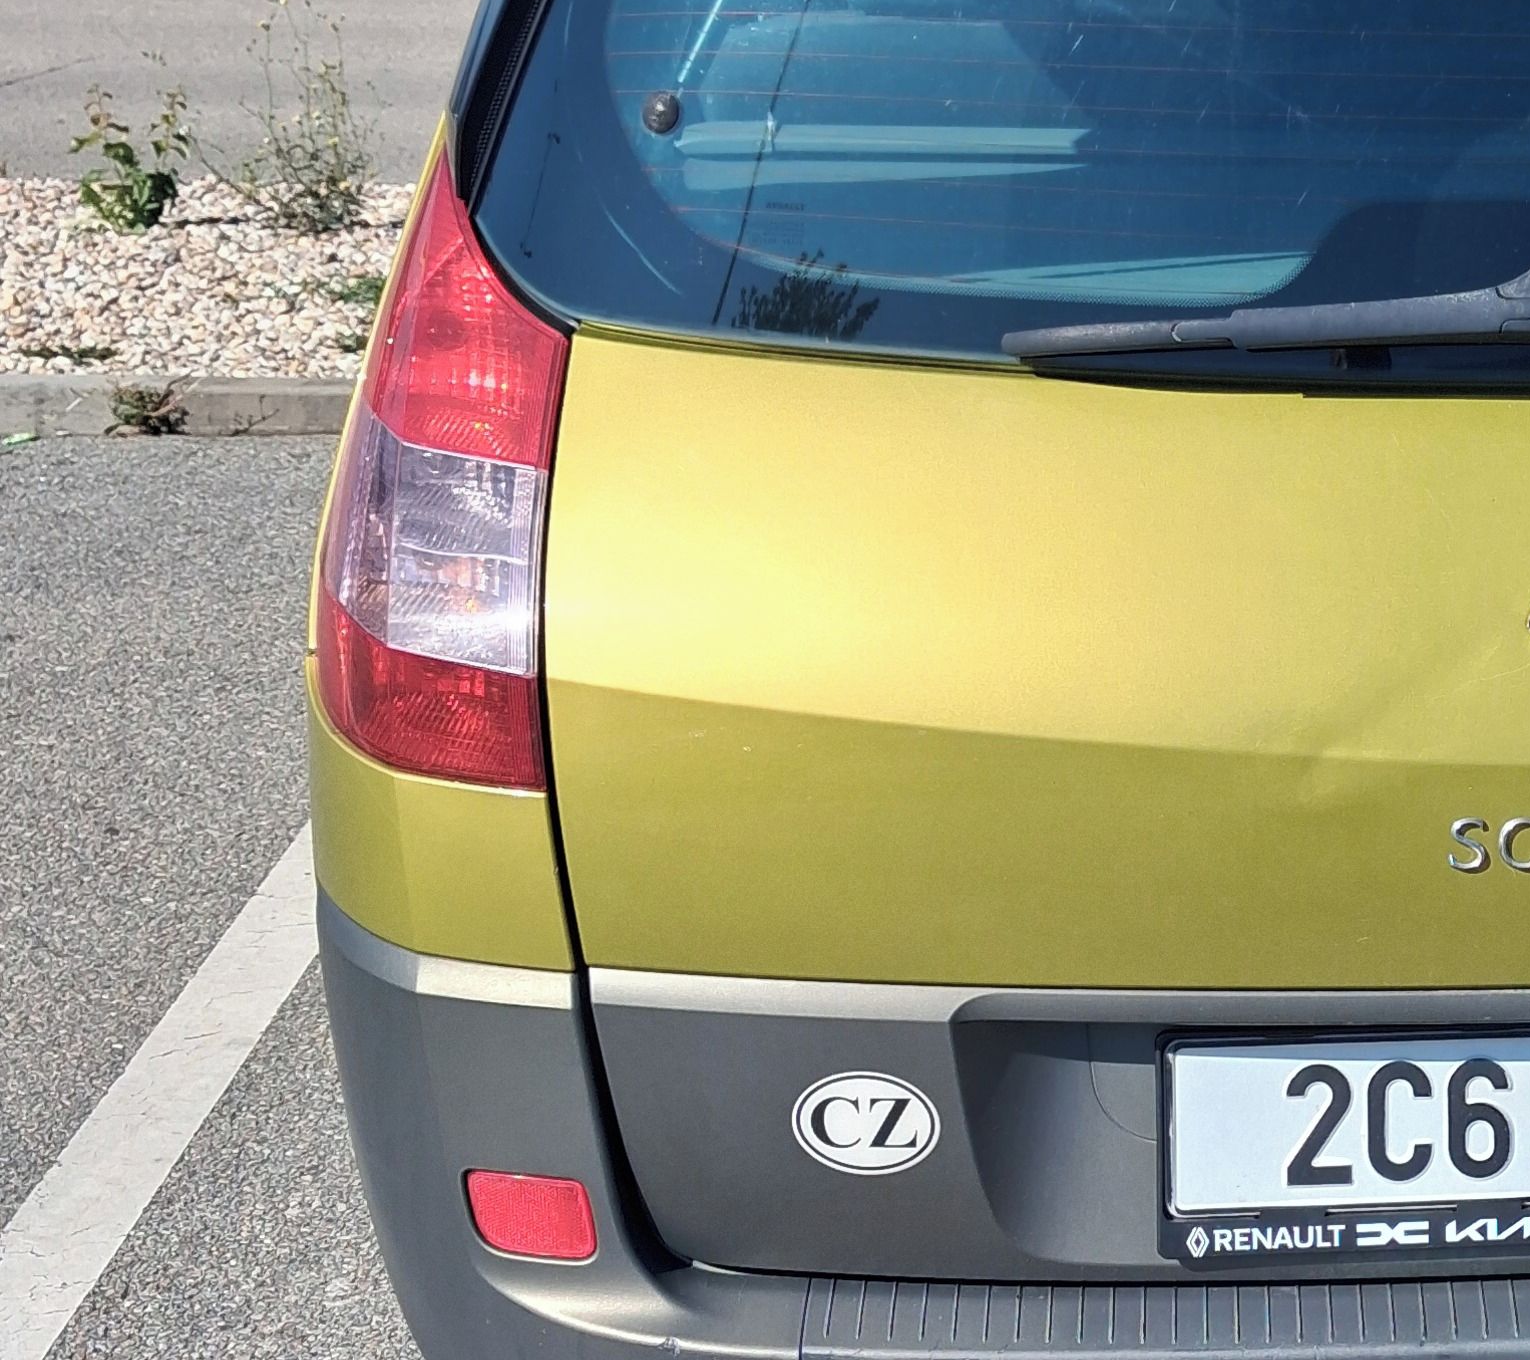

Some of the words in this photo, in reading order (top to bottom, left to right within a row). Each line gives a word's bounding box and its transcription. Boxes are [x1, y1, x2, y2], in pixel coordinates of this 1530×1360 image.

[810, 1096, 918, 1149] CZ
[1284, 1058, 1513, 1187] 2C6
[1213, 1223, 1347, 1253] RENAULT
